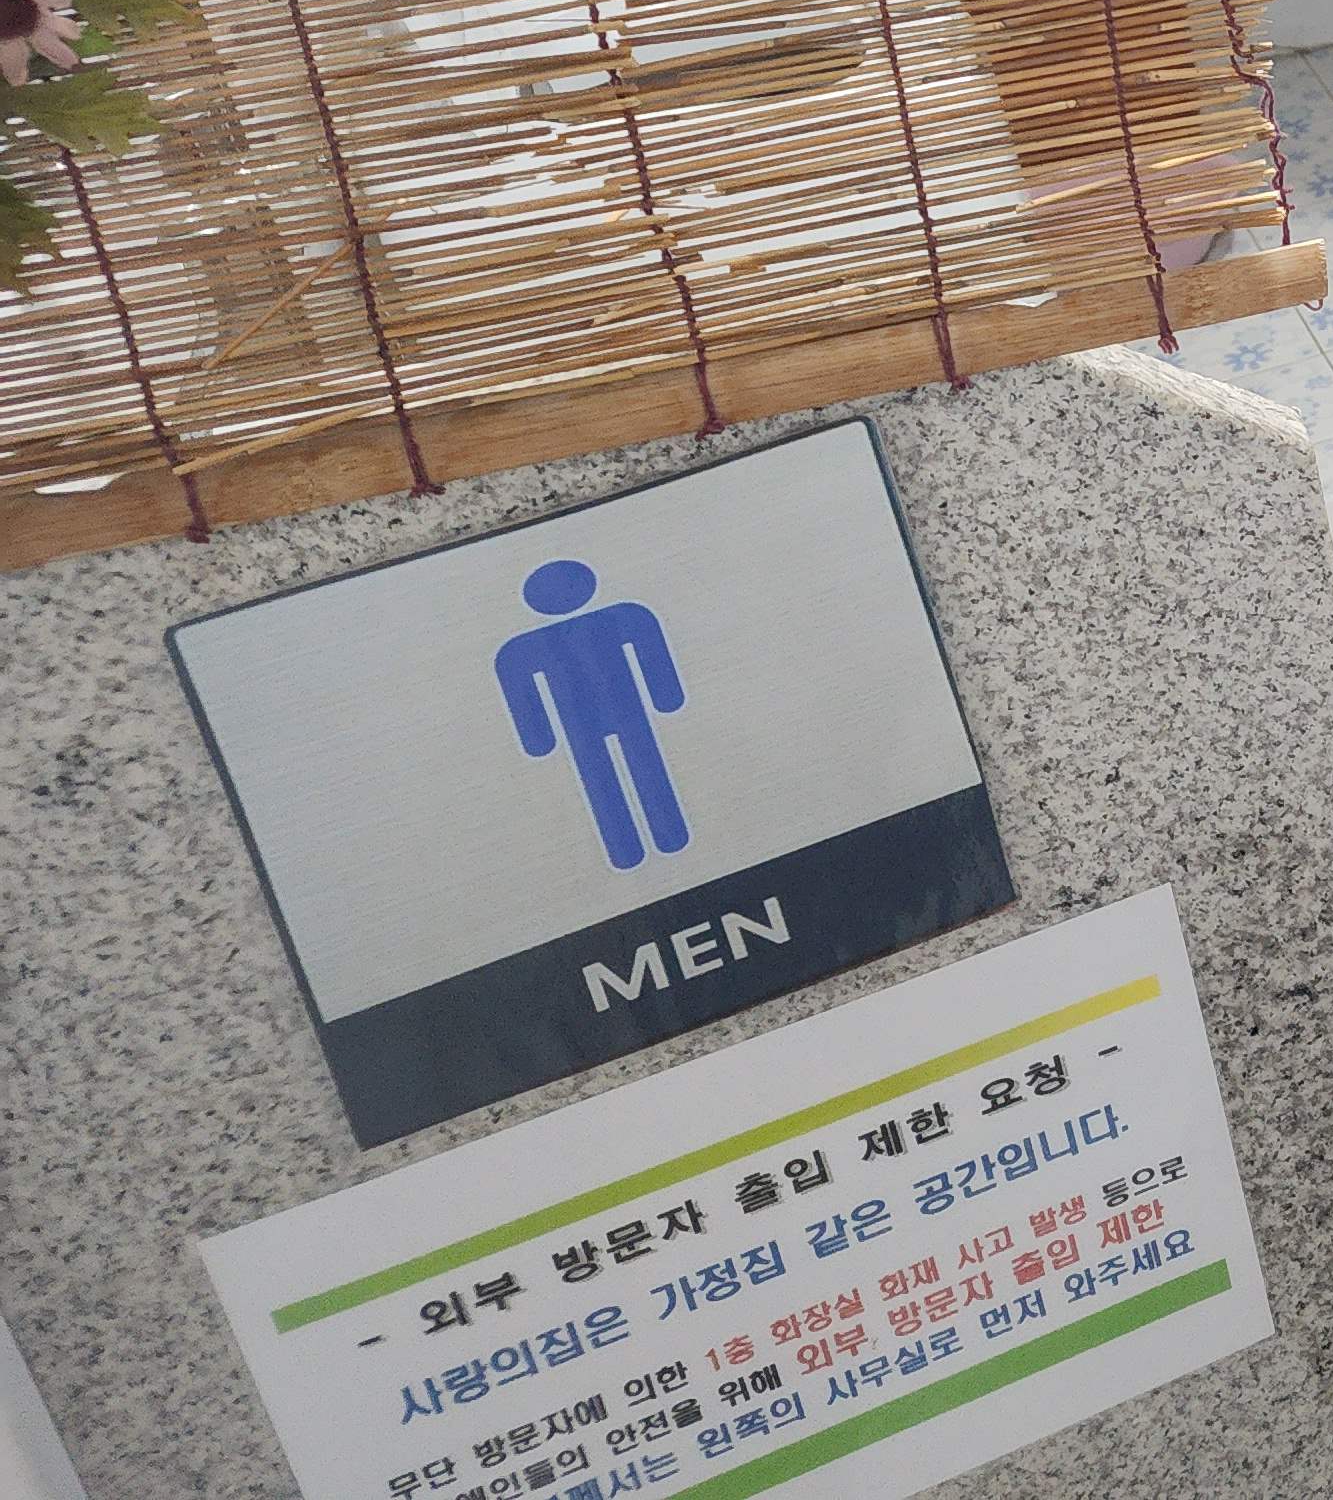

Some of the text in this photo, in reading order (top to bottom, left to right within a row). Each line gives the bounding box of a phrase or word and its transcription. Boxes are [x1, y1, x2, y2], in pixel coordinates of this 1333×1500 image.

[582, 896, 791, 1012] MEN
[388, 1155, 1189, 1500] 무단 방문자에 의한 1층 화장실 화재 사고 발생 등으로
[399, 1104, 1130, 1425] 사랑의집은 가정집 같은 공간입니다.
[418, 1271, 528, 1336] 외부
[552, 1199, 709, 1284] 방문자
[734, 1149, 835, 1215] 출입
[858, 1101, 955, 1163] 제한
[979, 1054, 1070, 1117] 요청
[605, 1397, 705, 1457] 안전을
[718, 1362, 784, 1408] 위해
[796, 1323, 870, 1377] 외부
[887, 1271, 995, 1338] 방문자
[1011, 1233, 1082, 1287] 출입
[1096, 1198, 1166, 1250] 제한
[544, 1229, 1196, 1500] 께서는 왼쪽의 사무실로 먼저 와주세요
